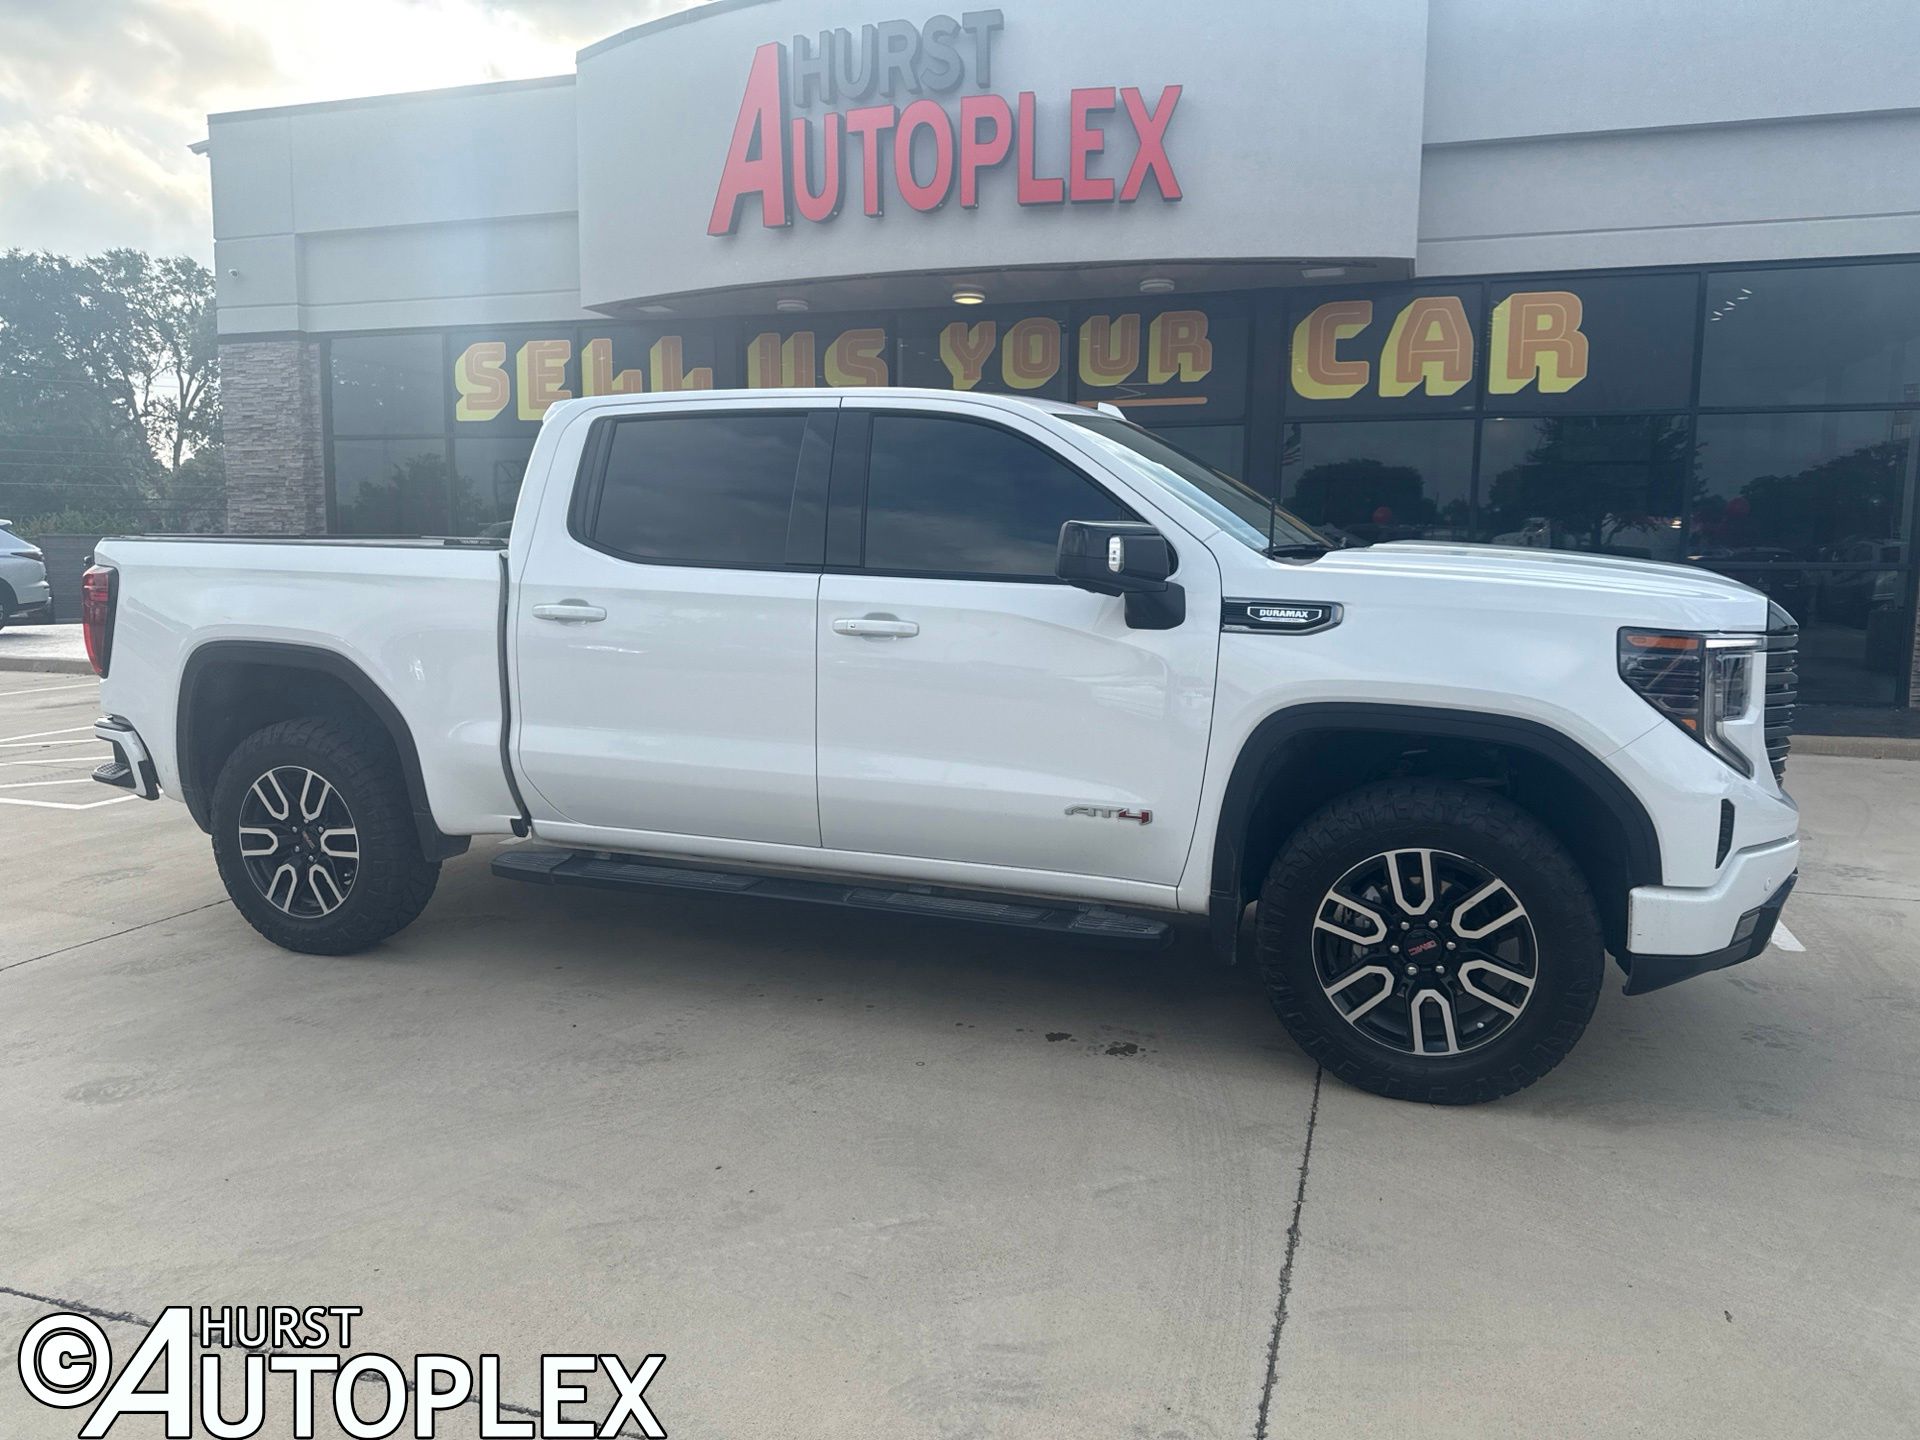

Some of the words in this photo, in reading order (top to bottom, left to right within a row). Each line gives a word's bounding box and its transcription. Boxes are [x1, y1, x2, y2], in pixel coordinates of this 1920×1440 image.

[793, 9, 1004, 107] HURST
[707, 41, 1183, 236] AUTOPLEX
[455, 339, 713, 422] SELL
[939, 311, 1213, 390] YOUR
[1291, 292, 1589, 399] CAR
[1259, 608, 1309, 618] DURAMAX
[1064, 804, 1153, 826] AT4
